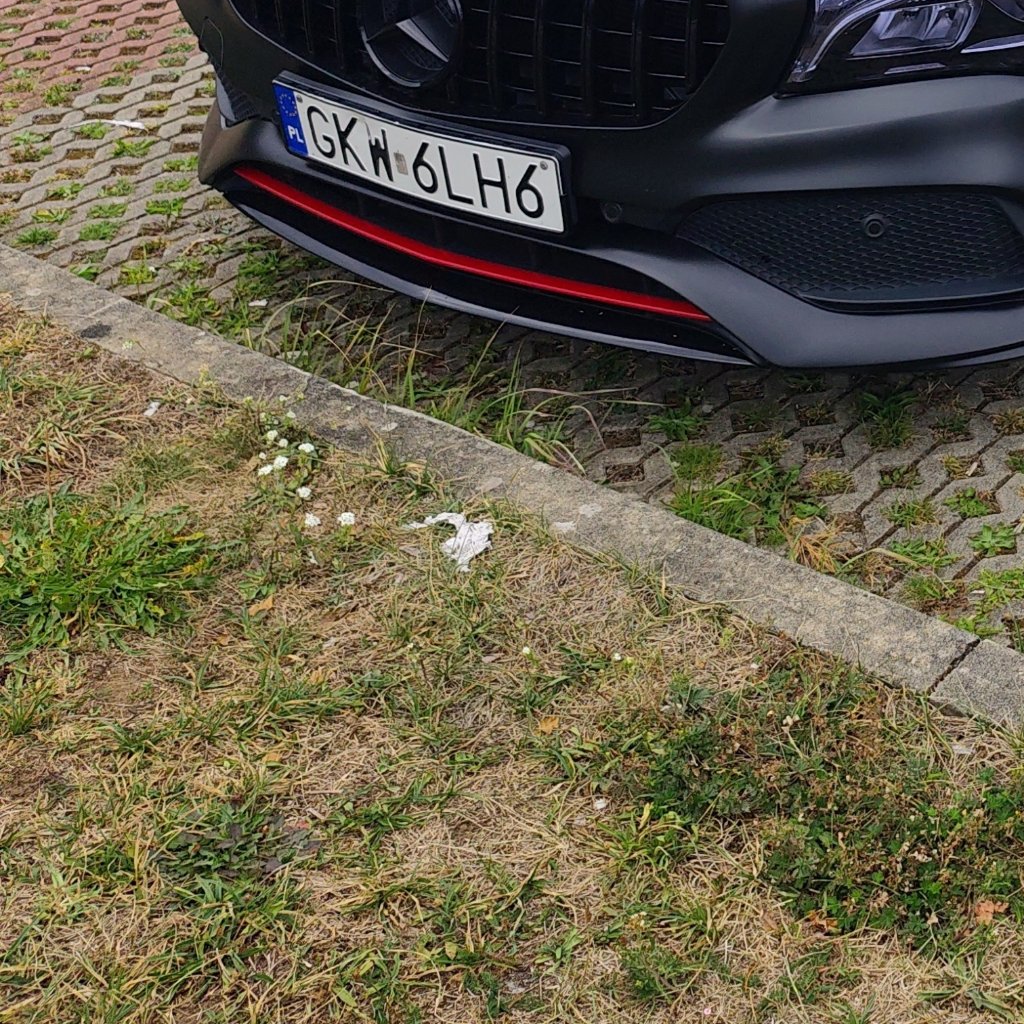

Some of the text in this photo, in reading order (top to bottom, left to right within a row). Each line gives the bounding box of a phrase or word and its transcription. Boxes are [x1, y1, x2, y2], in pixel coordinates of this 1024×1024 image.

[286, 124, 305, 144] PL
[306, 105, 545, 219] GKW 6LH6
